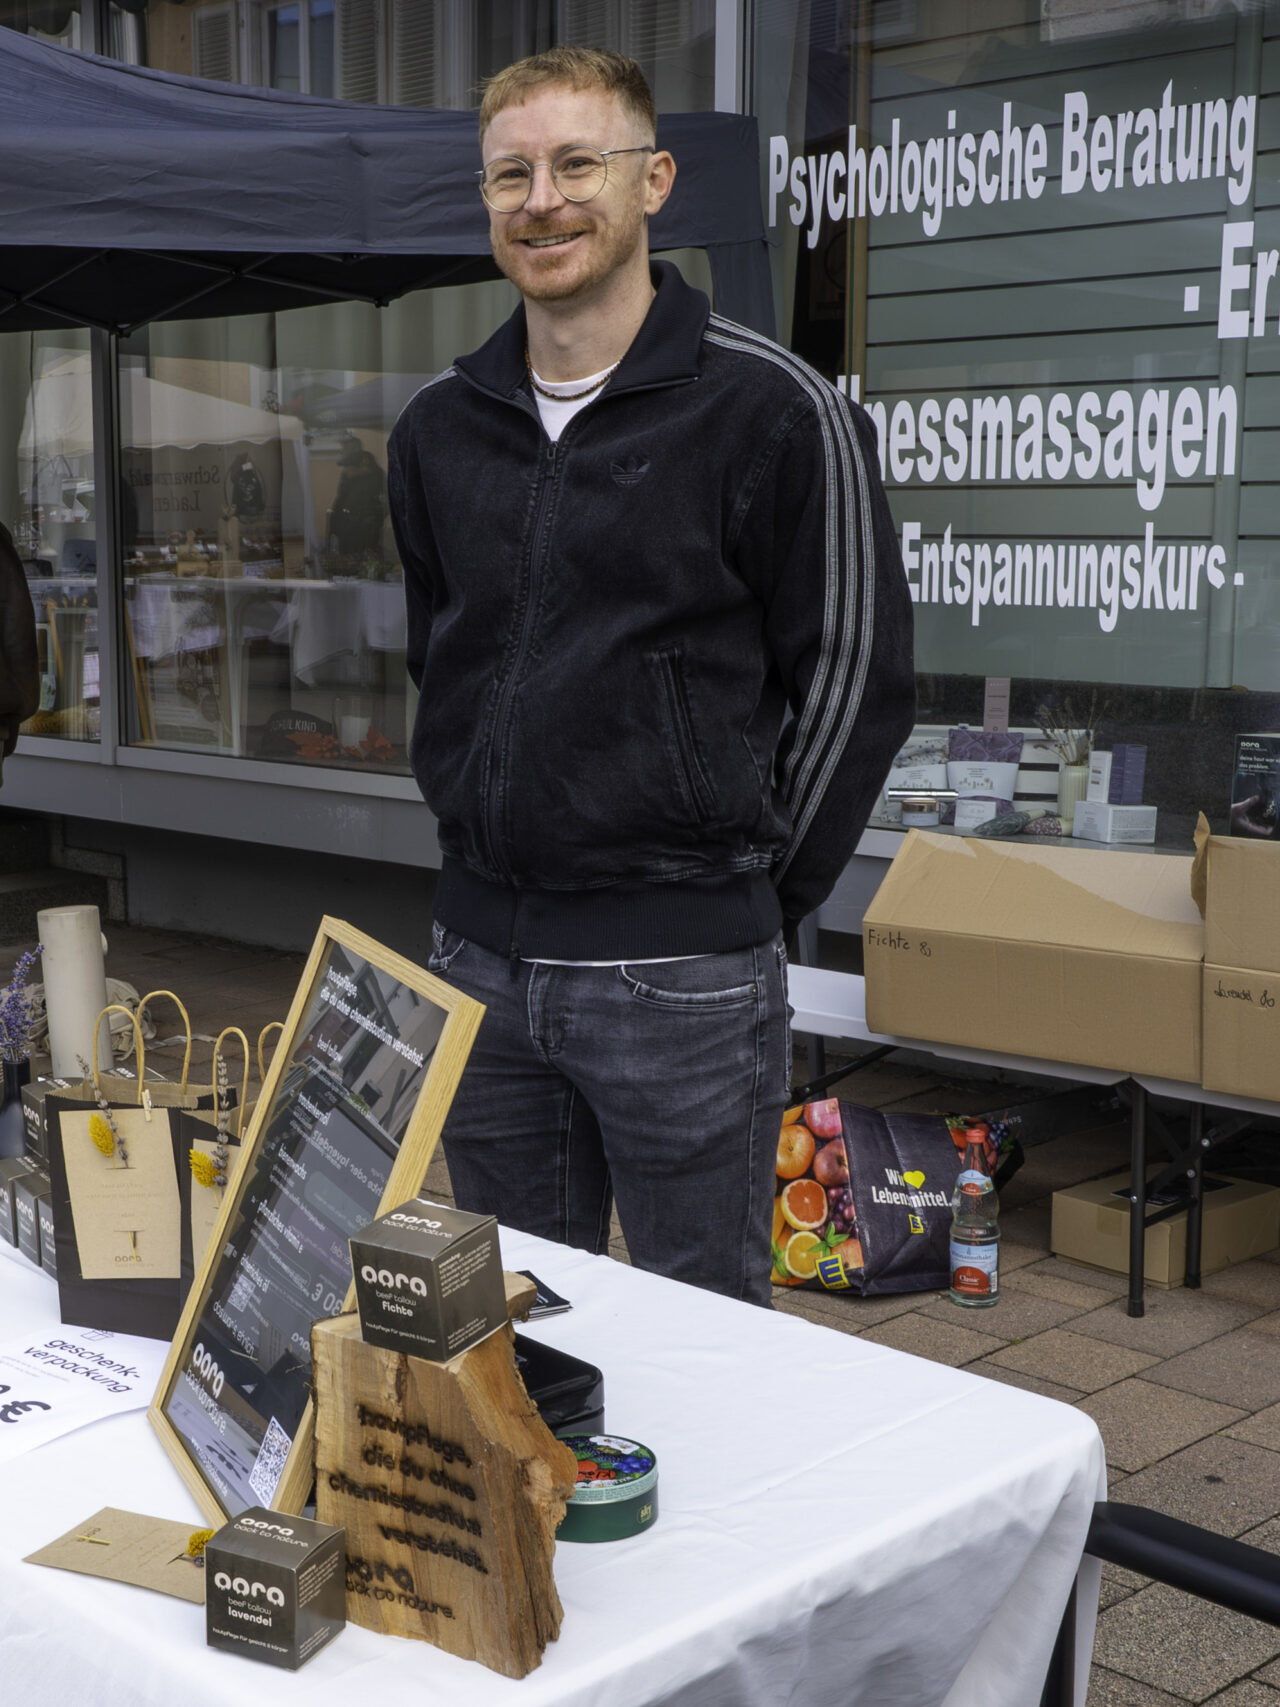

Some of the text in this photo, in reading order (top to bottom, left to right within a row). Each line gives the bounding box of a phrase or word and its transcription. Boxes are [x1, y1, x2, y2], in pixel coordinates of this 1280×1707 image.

[769, 79, 1257, 249] Psychologische Beratung
[1218, 221, 1280, 339] Er
[869, 928, 910, 950] Fichte
[885, 1168, 905, 1187] Wir
[382, 1219, 405, 1229] back
[406, 1223, 417, 1232] to
[376, 1289, 417, 1306] beef tallow
[382, 1301, 414, 1317] fichte
[24, 1346, 132, 1393] verpackung
[44, 1337, 140, 1380] geschenk-
[185, 1363, 199, 1395] back
[198, 1388, 208, 1405] to
[358, 1404, 472, 1468] hautpflege,
[363, 1444, 476, 1501] die du ohne
[329, 1472, 482, 1538] chemiestudium
[234, 1523, 257, 1534] back
[258, 1527, 270, 1537] to
[378, 1523, 488, 1575] verstehst.
[228, 1596, 271, 1615] beef tallow
[228, 1607, 272, 1628] lavendel
[374, 1585, 394, 1601] to
[398, 1595, 455, 1619] nature.
